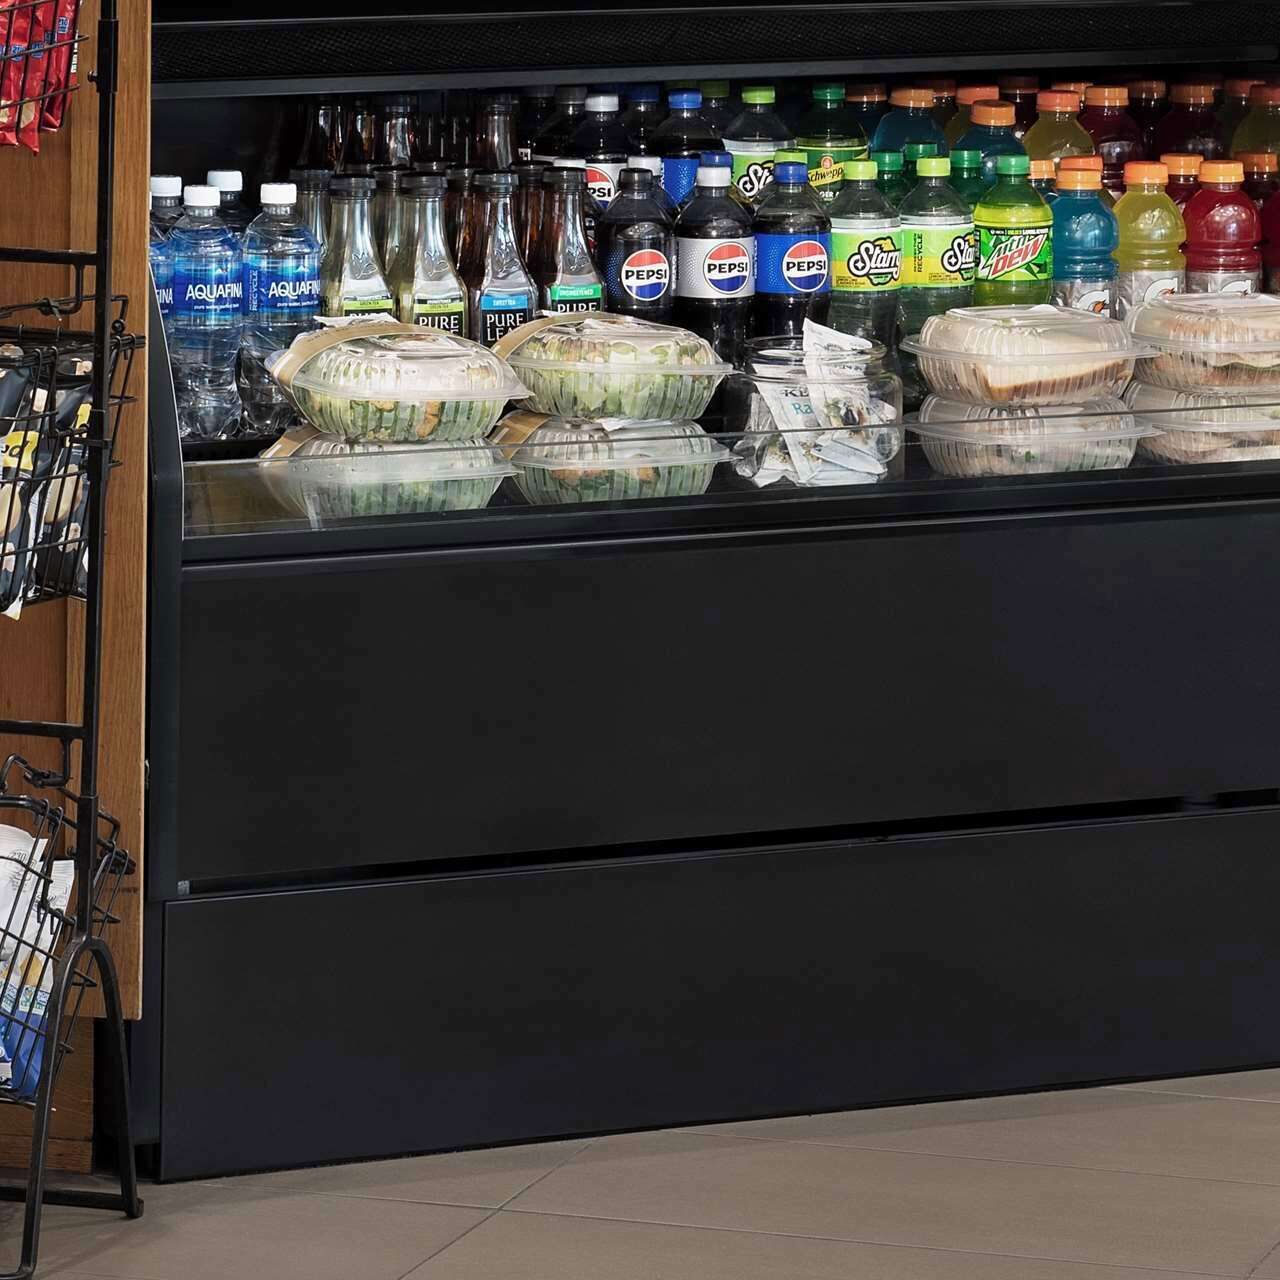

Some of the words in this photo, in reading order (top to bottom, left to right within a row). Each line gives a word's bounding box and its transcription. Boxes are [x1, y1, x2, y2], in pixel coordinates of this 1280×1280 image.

[588, 187, 612, 198] PSI
[707, 262, 748, 274] PEPSI
[786, 260, 826, 272] PEPSI
[625, 268, 667, 280] PEPSI
[185, 282, 243, 302] AQUAFINA
[419, 315, 459, 329] PURE
[486, 312, 524, 328] PURE
